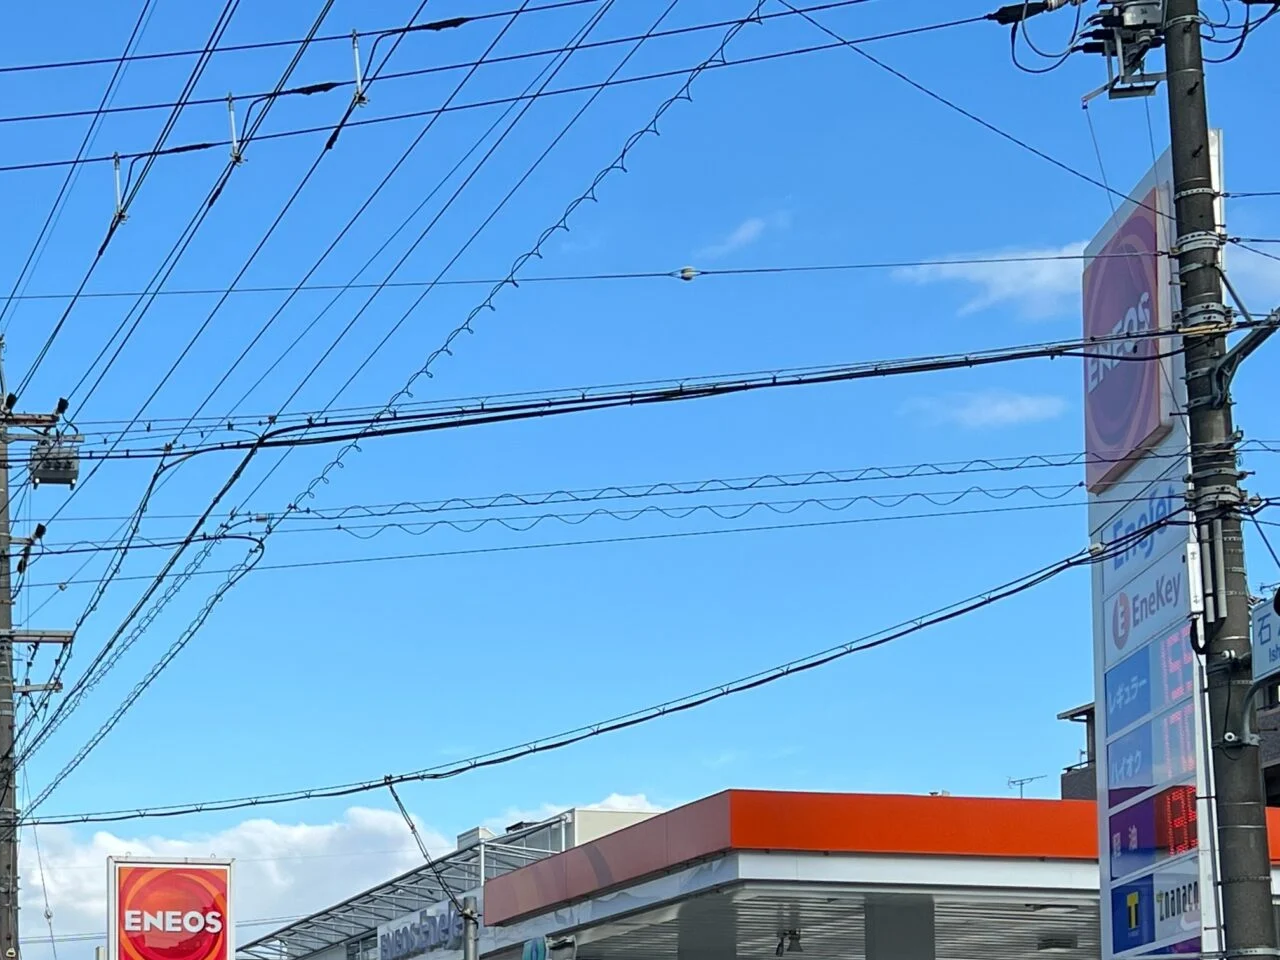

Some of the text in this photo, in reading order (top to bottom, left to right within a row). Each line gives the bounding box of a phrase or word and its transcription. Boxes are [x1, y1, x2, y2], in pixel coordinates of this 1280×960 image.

[1086, 291, 1151, 393] ENEOS
[1132, 572, 1181, 628] EneKey
[124, 910, 222, 934] ENEOS
